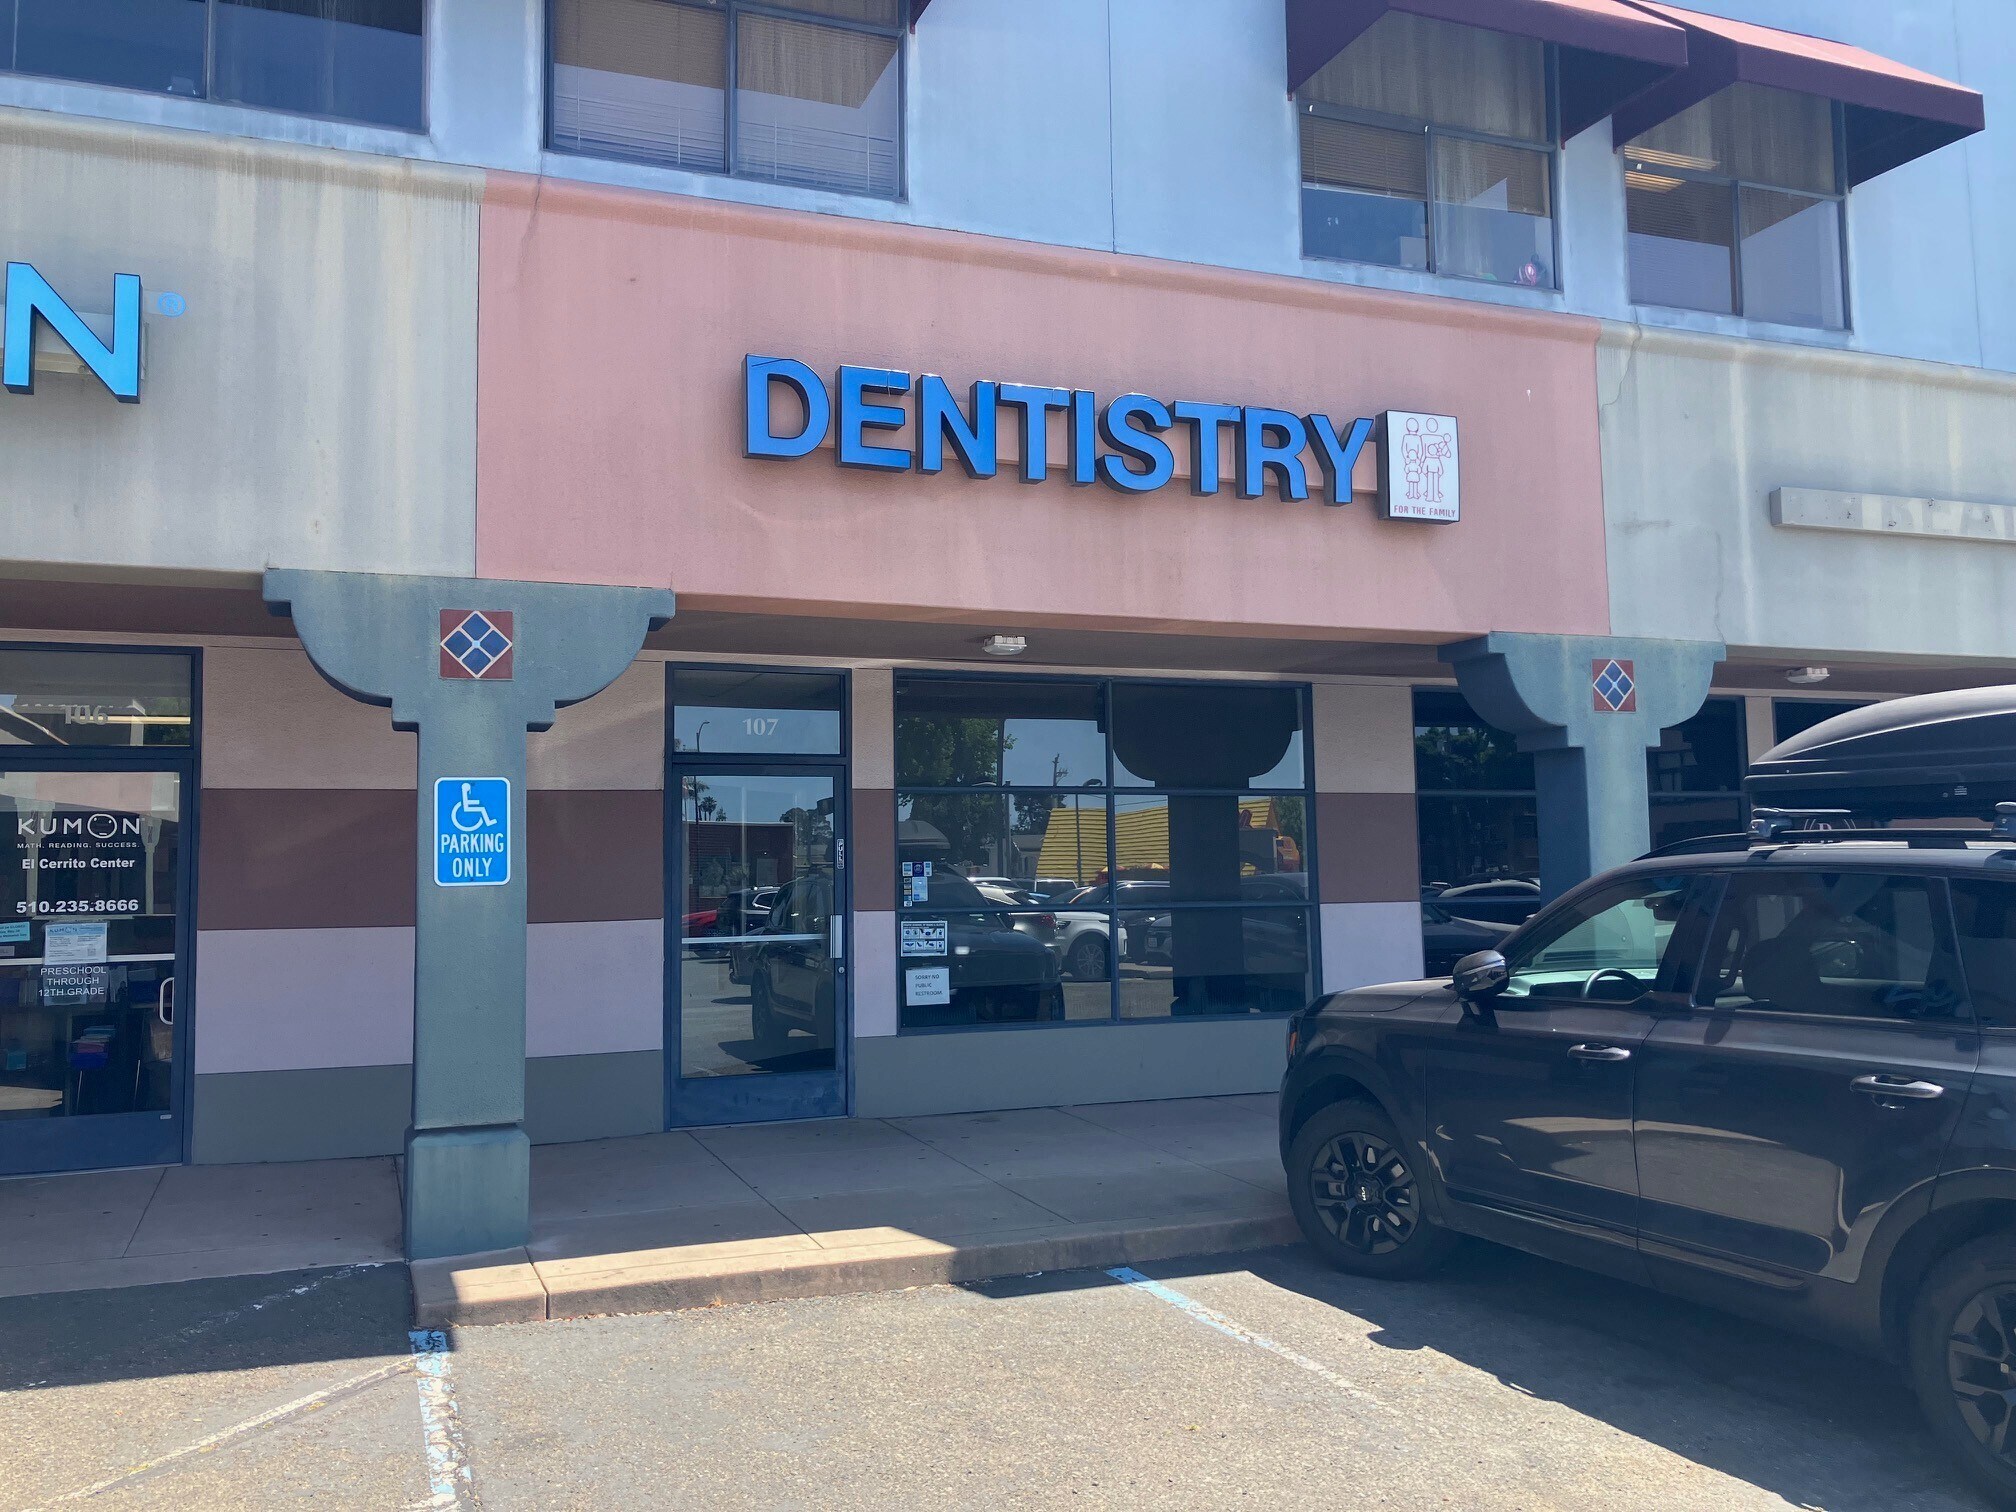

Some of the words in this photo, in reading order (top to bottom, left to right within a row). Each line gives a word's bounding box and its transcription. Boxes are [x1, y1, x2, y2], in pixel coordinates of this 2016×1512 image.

[741, 353, 1375, 507] DENTISTRY
[1393, 504, 1409, 514] FOR
[1412, 506, 1426, 515] THE
[1429, 507, 1456, 518] FAMILY
[64, 704, 108, 726] 106
[742, 717, 779, 736] 107
[17, 813, 140, 839] KUMON
[440, 832, 505, 854] PARKING
[22, 858, 35, 870] El
[39, 858, 86, 869] Cerrito
[90, 857, 135, 869] Center
[452, 857, 493, 878] ONLY
[16, 899, 139, 913] 510.235.8666
[40, 966, 107, 975] PRESCHOOL
[47, 977, 100, 986] THROUGH
[38, 988, 64, 997] 12TH
[67, 986, 105, 996] GRADE
